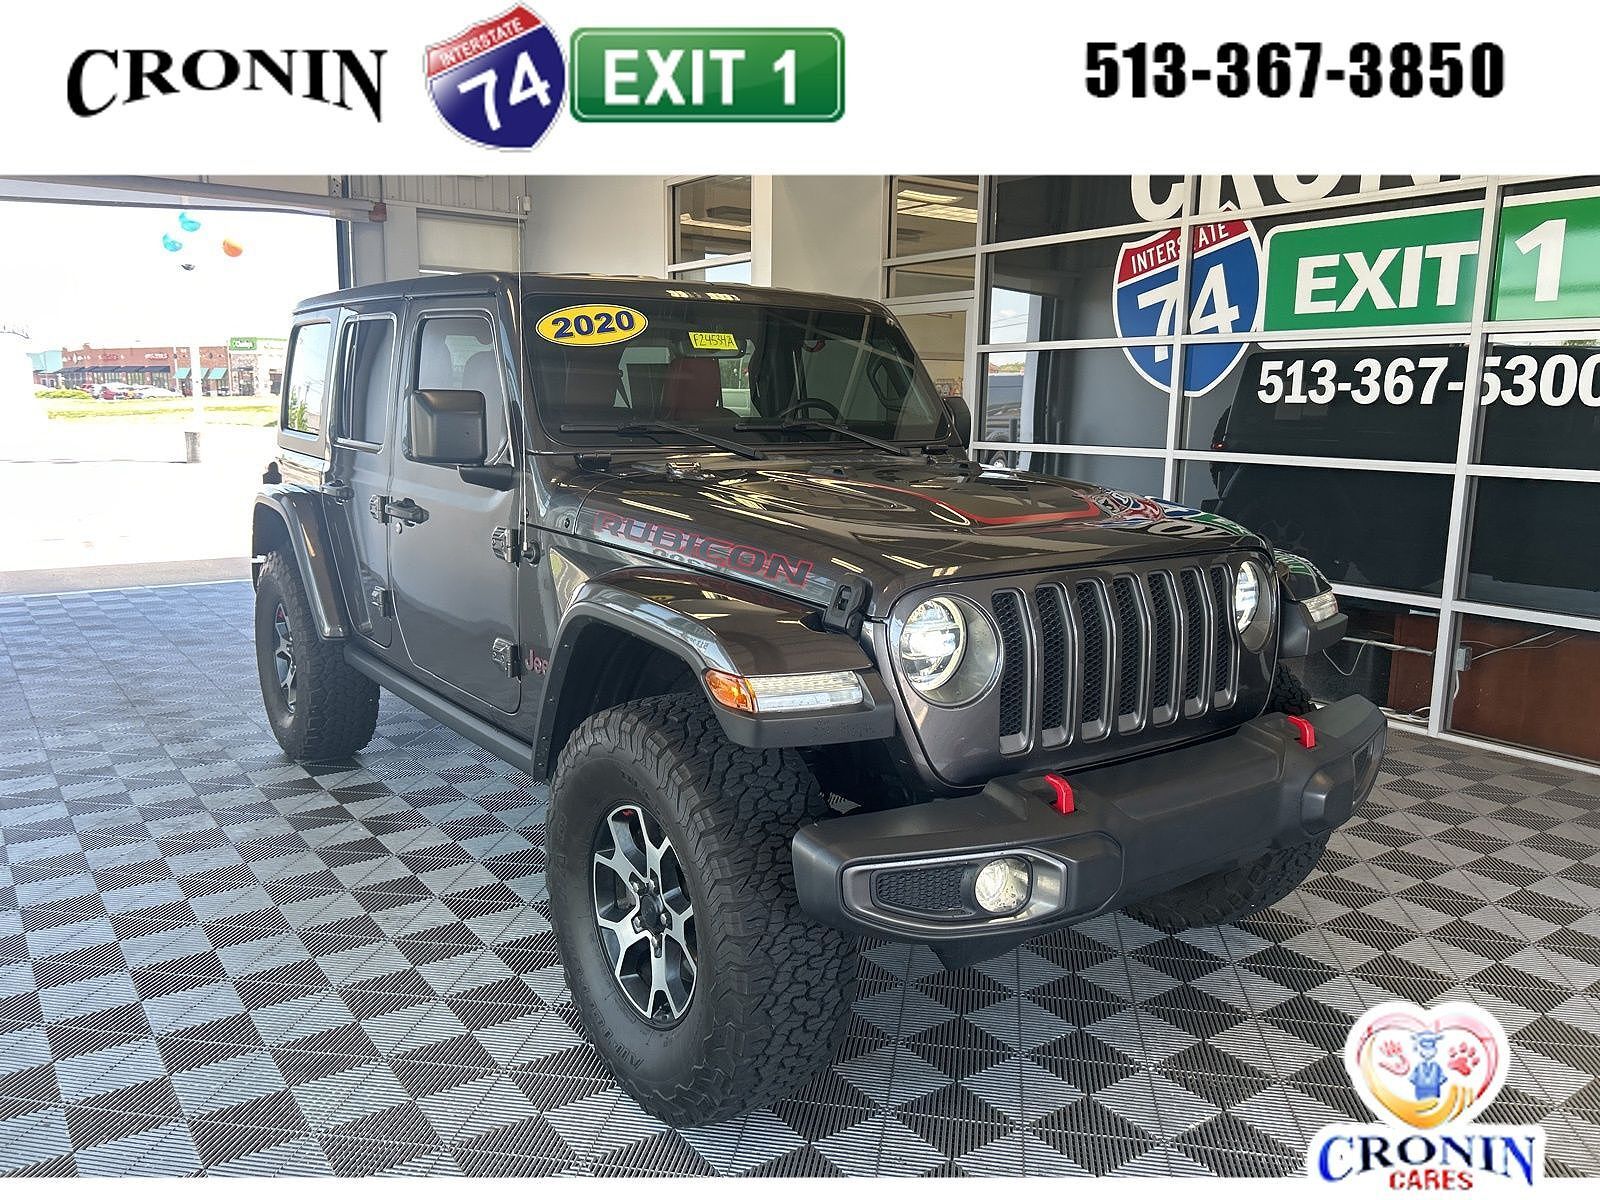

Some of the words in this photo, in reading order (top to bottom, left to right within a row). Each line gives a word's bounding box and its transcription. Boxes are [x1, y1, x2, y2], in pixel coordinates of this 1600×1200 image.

[1294, 240, 1480, 314] EXIT
[1515, 218, 1567, 302] 1
[551, 309, 634, 338] 2020
[1137, 263, 1240, 363] 74
[593, 511, 813, 588] RUBICON
